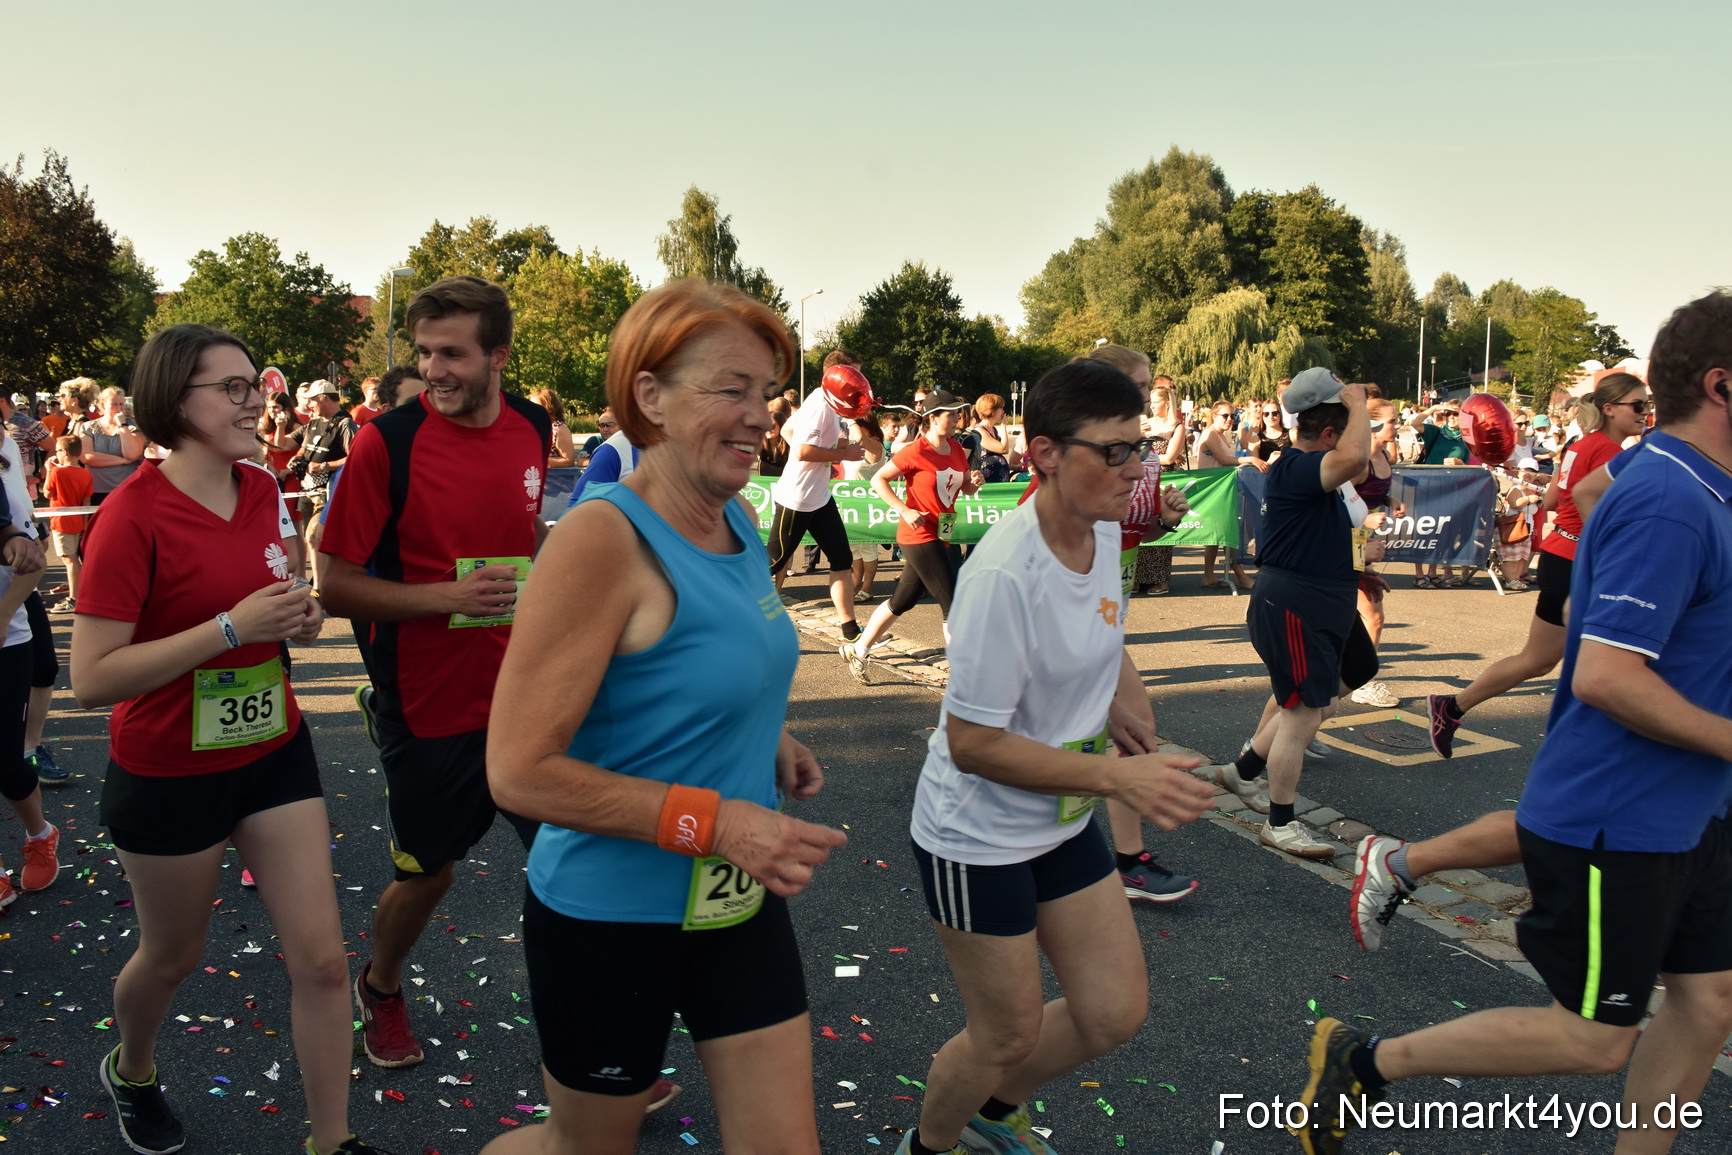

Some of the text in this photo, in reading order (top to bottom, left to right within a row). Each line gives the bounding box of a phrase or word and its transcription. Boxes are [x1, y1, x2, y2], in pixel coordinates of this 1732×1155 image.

[868, 503, 900, 528] be
[1374, 515, 1452, 536] cner
[1383, 539, 1438, 549] MOBILE
[219, 690, 272, 726] 365
[222, 720, 272, 735] Beck Theresa
[706, 863, 761, 901] 20
